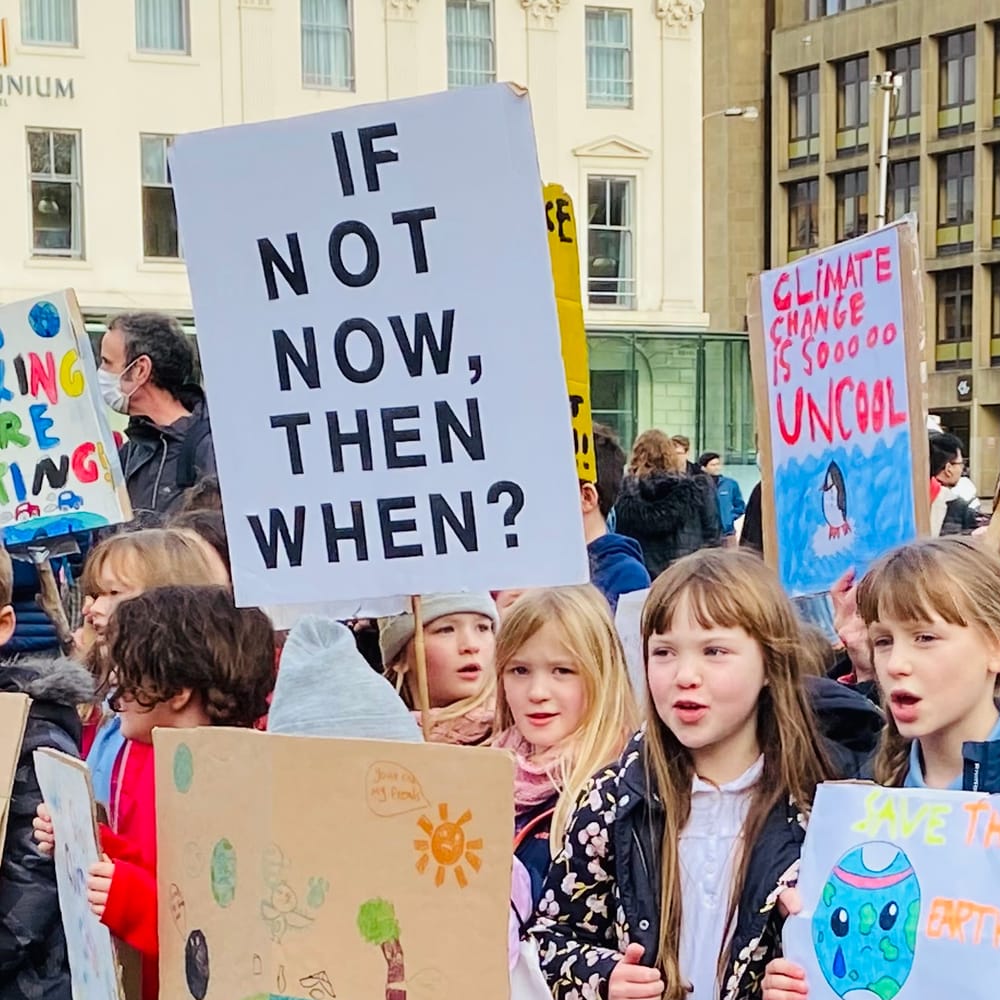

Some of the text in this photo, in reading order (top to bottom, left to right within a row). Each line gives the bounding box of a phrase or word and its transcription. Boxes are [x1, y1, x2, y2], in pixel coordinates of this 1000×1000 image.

[331, 122, 399, 197] IF
[257, 206, 437, 301] NOT
[272, 309, 482, 391] NOW,
[770, 291, 864, 346] CHANGE
[270, 397, 486, 475] THEN
[776, 376, 907, 446] UNCOOL
[246, 480, 525, 570] WHEN?
[852, 788, 950, 846] SAVE
